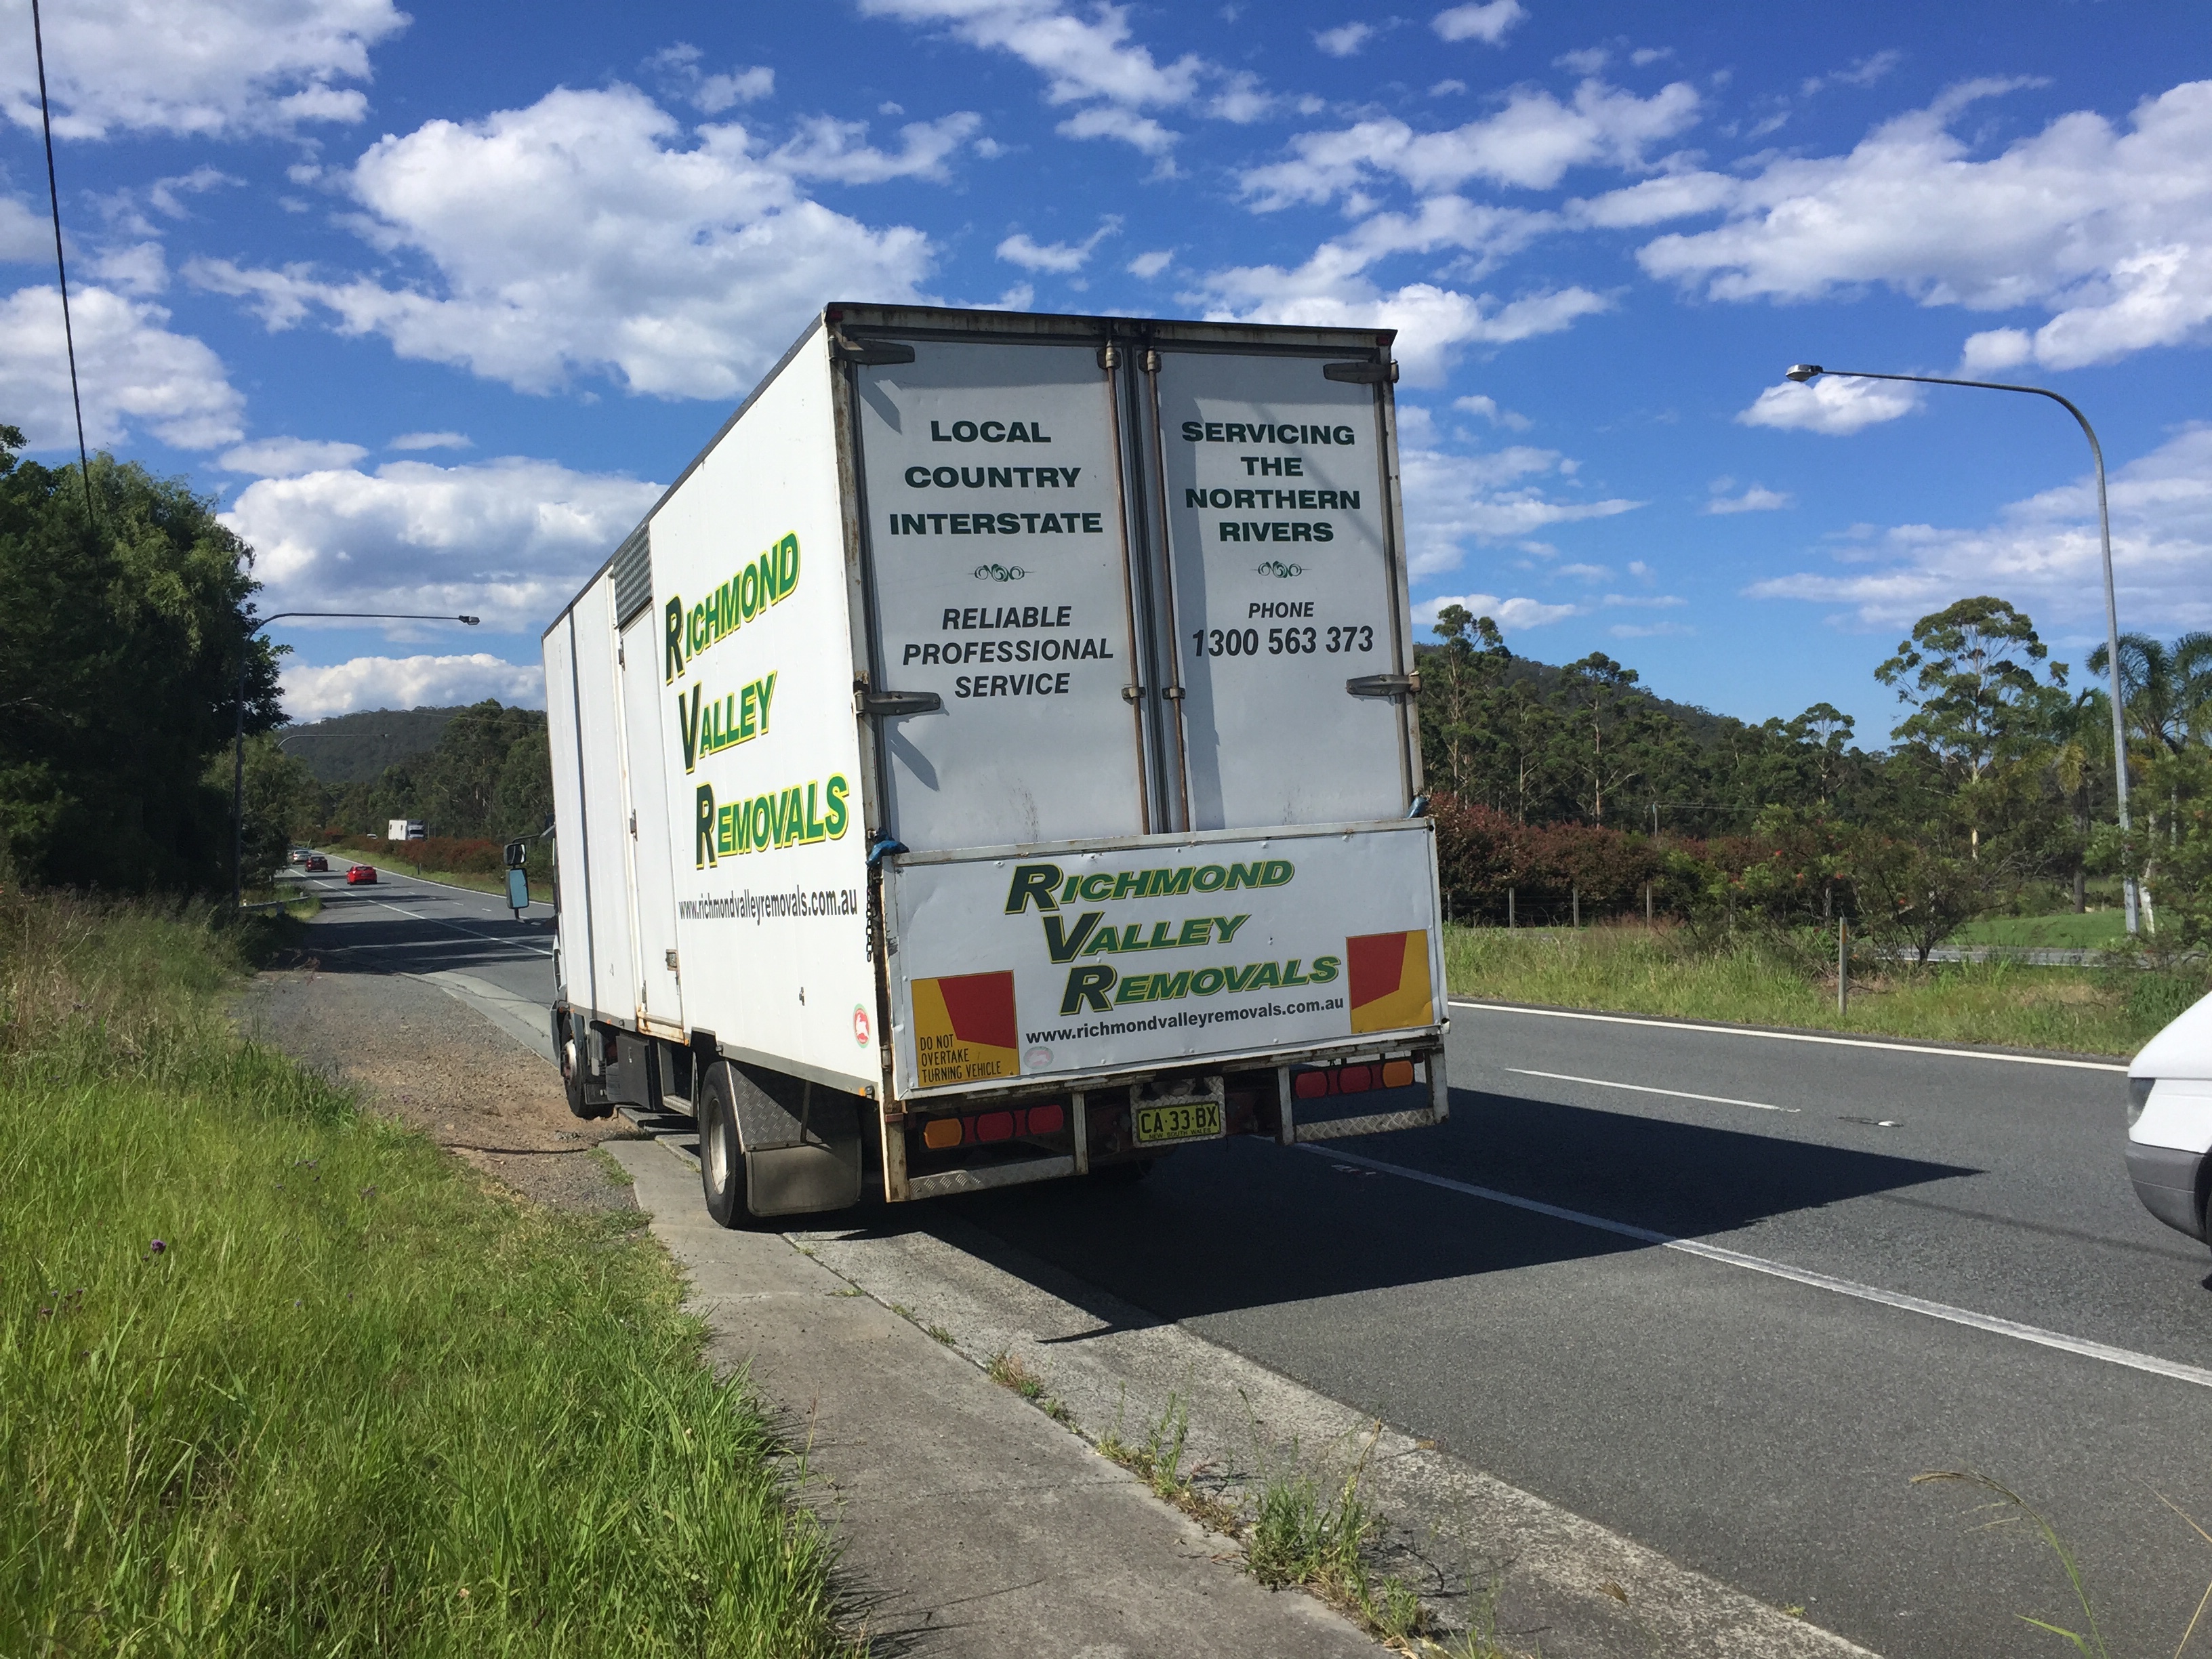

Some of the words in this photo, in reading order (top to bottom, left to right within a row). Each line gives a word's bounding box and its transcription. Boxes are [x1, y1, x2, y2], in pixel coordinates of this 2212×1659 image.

[930, 420, 1051, 443] LOCAL
[1182, 422, 1355, 445] SERVICING
[904, 466, 1081, 488] COUNTRY
[1241, 457, 1303, 476] THE
[1185, 489, 1360, 510] NORTHERN
[890, 513, 1103, 535] INTERSTATE
[1219, 522, 1334, 542] RIVERS
[666, 531, 800, 684] RICHMOND
[942, 606, 1071, 630] RELIABLE
[1248, 602, 1315, 619] PHONE
[902, 638, 1114, 665] PROFESSIONAL
[1193, 629, 1260, 657] 1300
[1268, 628, 1316, 656] 563
[1325, 626, 1374, 653] 373
[954, 672, 1070, 698] SERVICE
[678, 670, 777, 774] VALLEY
[695, 773, 849, 869] REMOVALS
[1005, 859, 1294, 914] RICHMOND
[678, 884, 858, 926] www.richmondvalleyremovals.com.au
[1042, 912, 1251, 963] VALLEY
[1060, 956, 1341, 1015] REMOVALS
[1026, 998, 1344, 1044] www.richmondvalleyremovals.com.au
[920, 1037, 933, 1050] DO
[937, 1034, 954, 1048] NOT
[922, 1048, 969, 1067] OVERTAKE
[922, 1066, 962, 1083] TURNING
[966, 1061, 1001, 1078] VEHICLE
